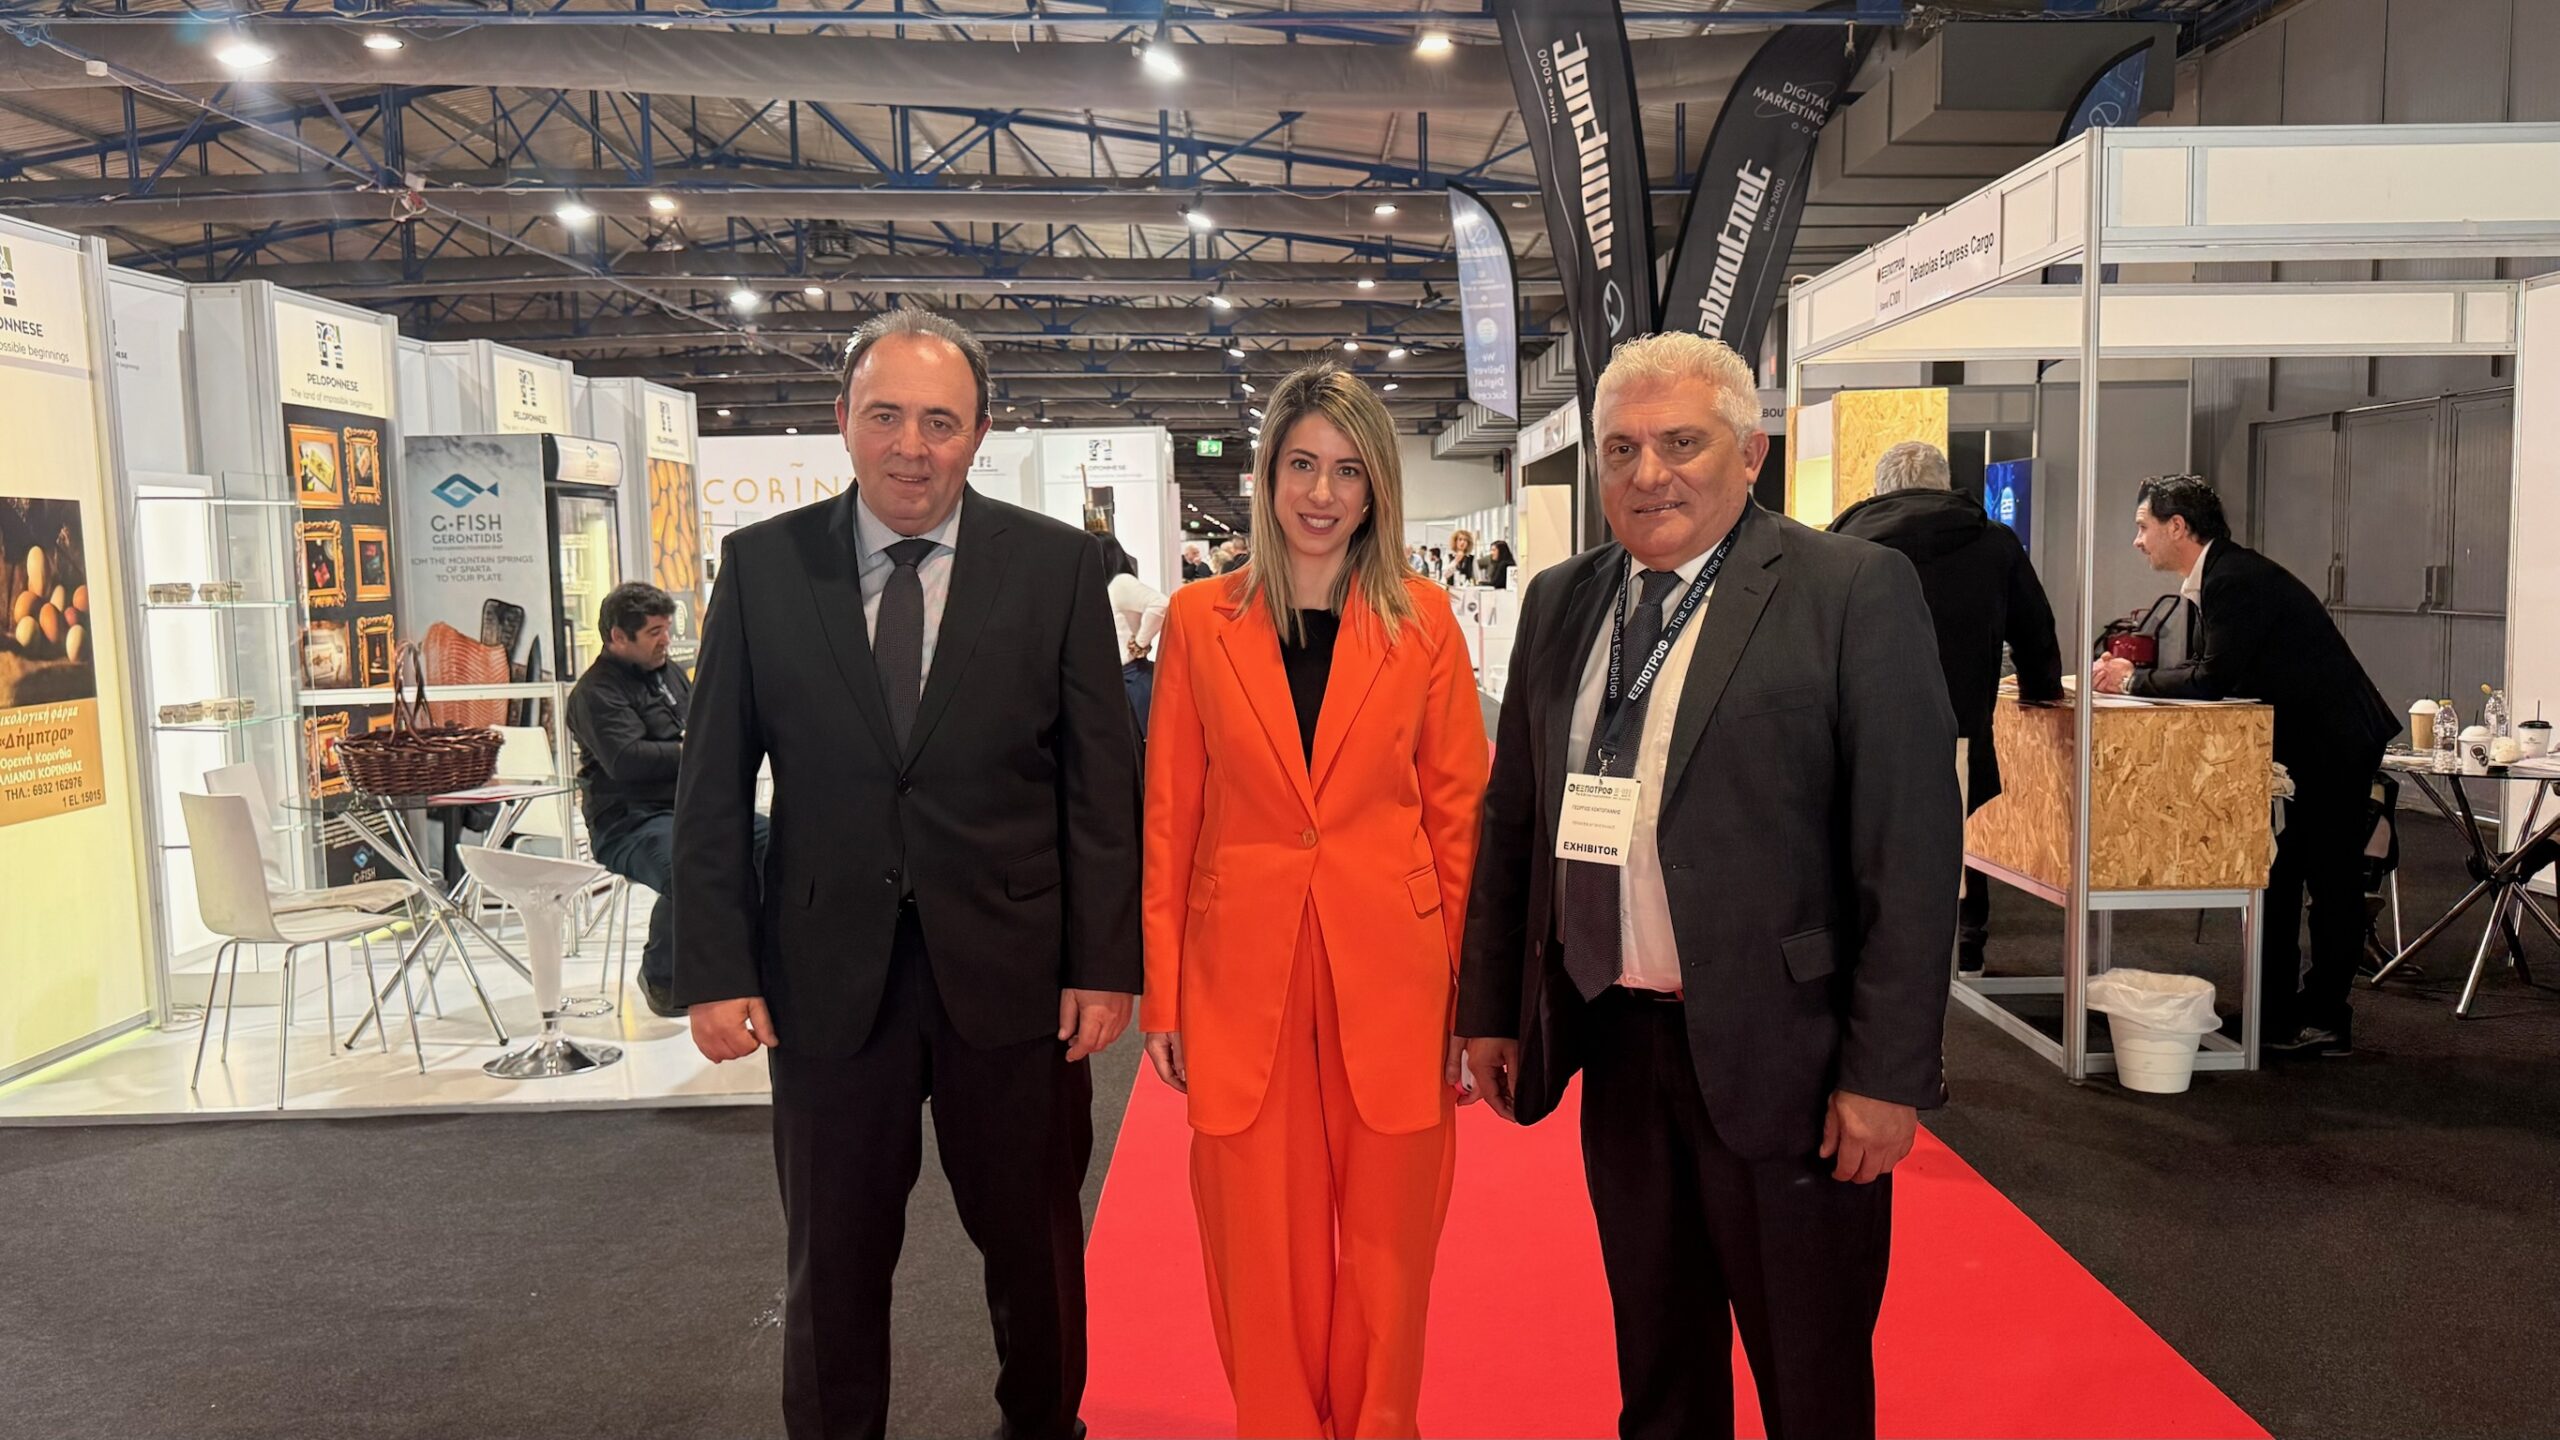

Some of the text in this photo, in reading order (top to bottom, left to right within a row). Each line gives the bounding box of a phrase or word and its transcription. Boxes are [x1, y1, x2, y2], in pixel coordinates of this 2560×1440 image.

[1753, 86, 1826, 126] MARKETING
[1782, 81, 1831, 112] DIGITAL
[1763, 178, 1786, 232] since 2000
[1698, 159, 1772, 339] aboutnet
[1909, 256, 1939, 283] Delatolas
[1940, 242, 1969, 269] Express
[1970, 231, 1995, 256] Cargo
[28, 344, 70, 363] beginnings
[306, 373, 359, 392] PELOPONNESE
[1762, 408, 1787, 418] BOU
[432, 533, 503, 545] GERONTIDIS
[448, 555, 495, 565] MOUNTAIN
[496, 555, 534, 564] SPRINGS
[461, 565, 492, 573] SPARTA
[451, 574, 475, 582] YOUR
[477, 573, 502, 582] PLATE
[1669, 611, 1688, 631] The
[1682, 579, 1707, 610] Greek
[1701, 558, 1721, 581] Fine
[1608, 644, 1621, 699] Exhibition
[51, 704, 79, 724] φάρμα
[1, 745, 73, 771] Ορεινή Κορινθία
[38, 760, 83, 779] ΚΟΡΙΝΘΙΑΣ
[32, 782, 53, 796] 6932
[55, 776, 83, 792] 162976
[69, 795, 80, 807] EL
[81, 789, 102, 803] 15015
[1563, 841, 1618, 856] EXHIBITOR
